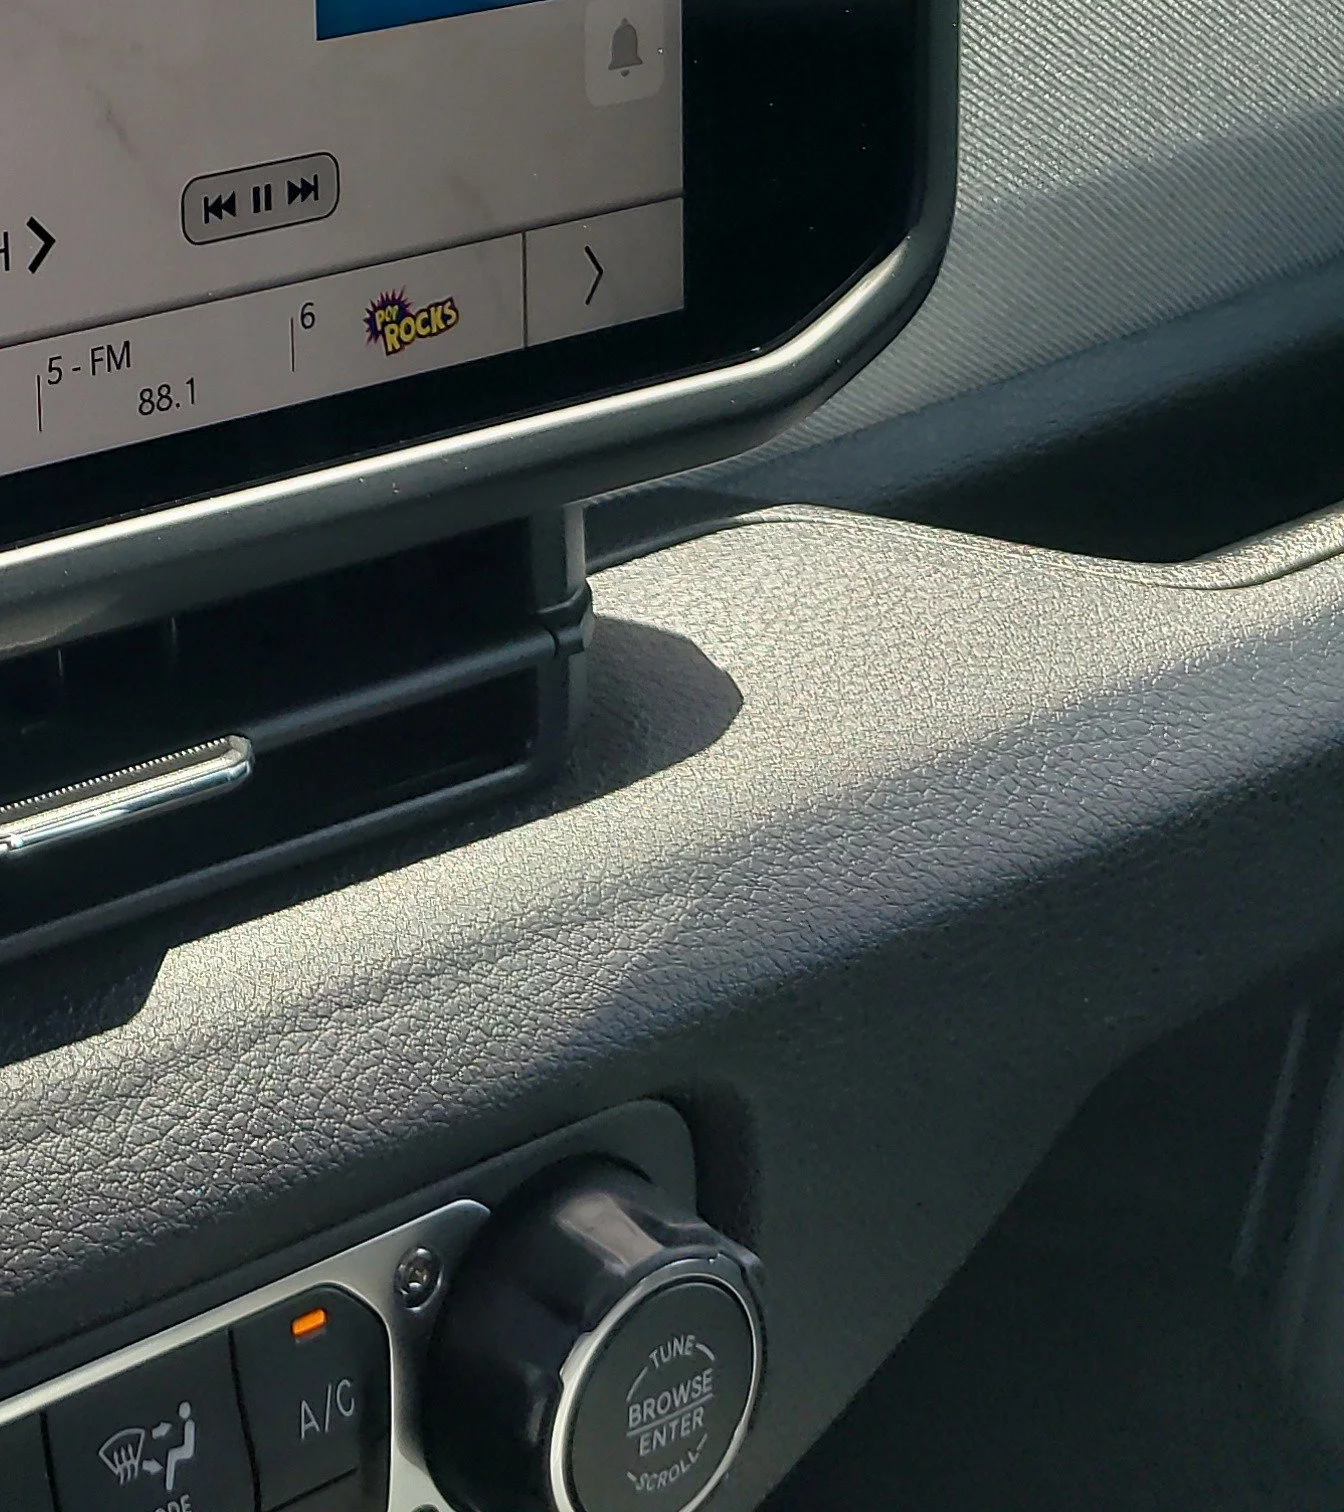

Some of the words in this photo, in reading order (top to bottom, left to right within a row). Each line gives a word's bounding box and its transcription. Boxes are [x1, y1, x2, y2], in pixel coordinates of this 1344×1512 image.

[299, 303, 316, 332] 6
[383, 300, 458, 353] ROCKS
[47, 355, 63, 385] 5
[90, 340, 131, 376] FM
[138, 376, 196, 417] 88.1
[649, 1334, 696, 1369] TUNE
[299, 1379, 355, 1441] A/C
[628, 1368, 714, 1429] BROWSE
[639, 1405, 705, 1457] ENTER
[634, 1450, 700, 1491] SCROLL
